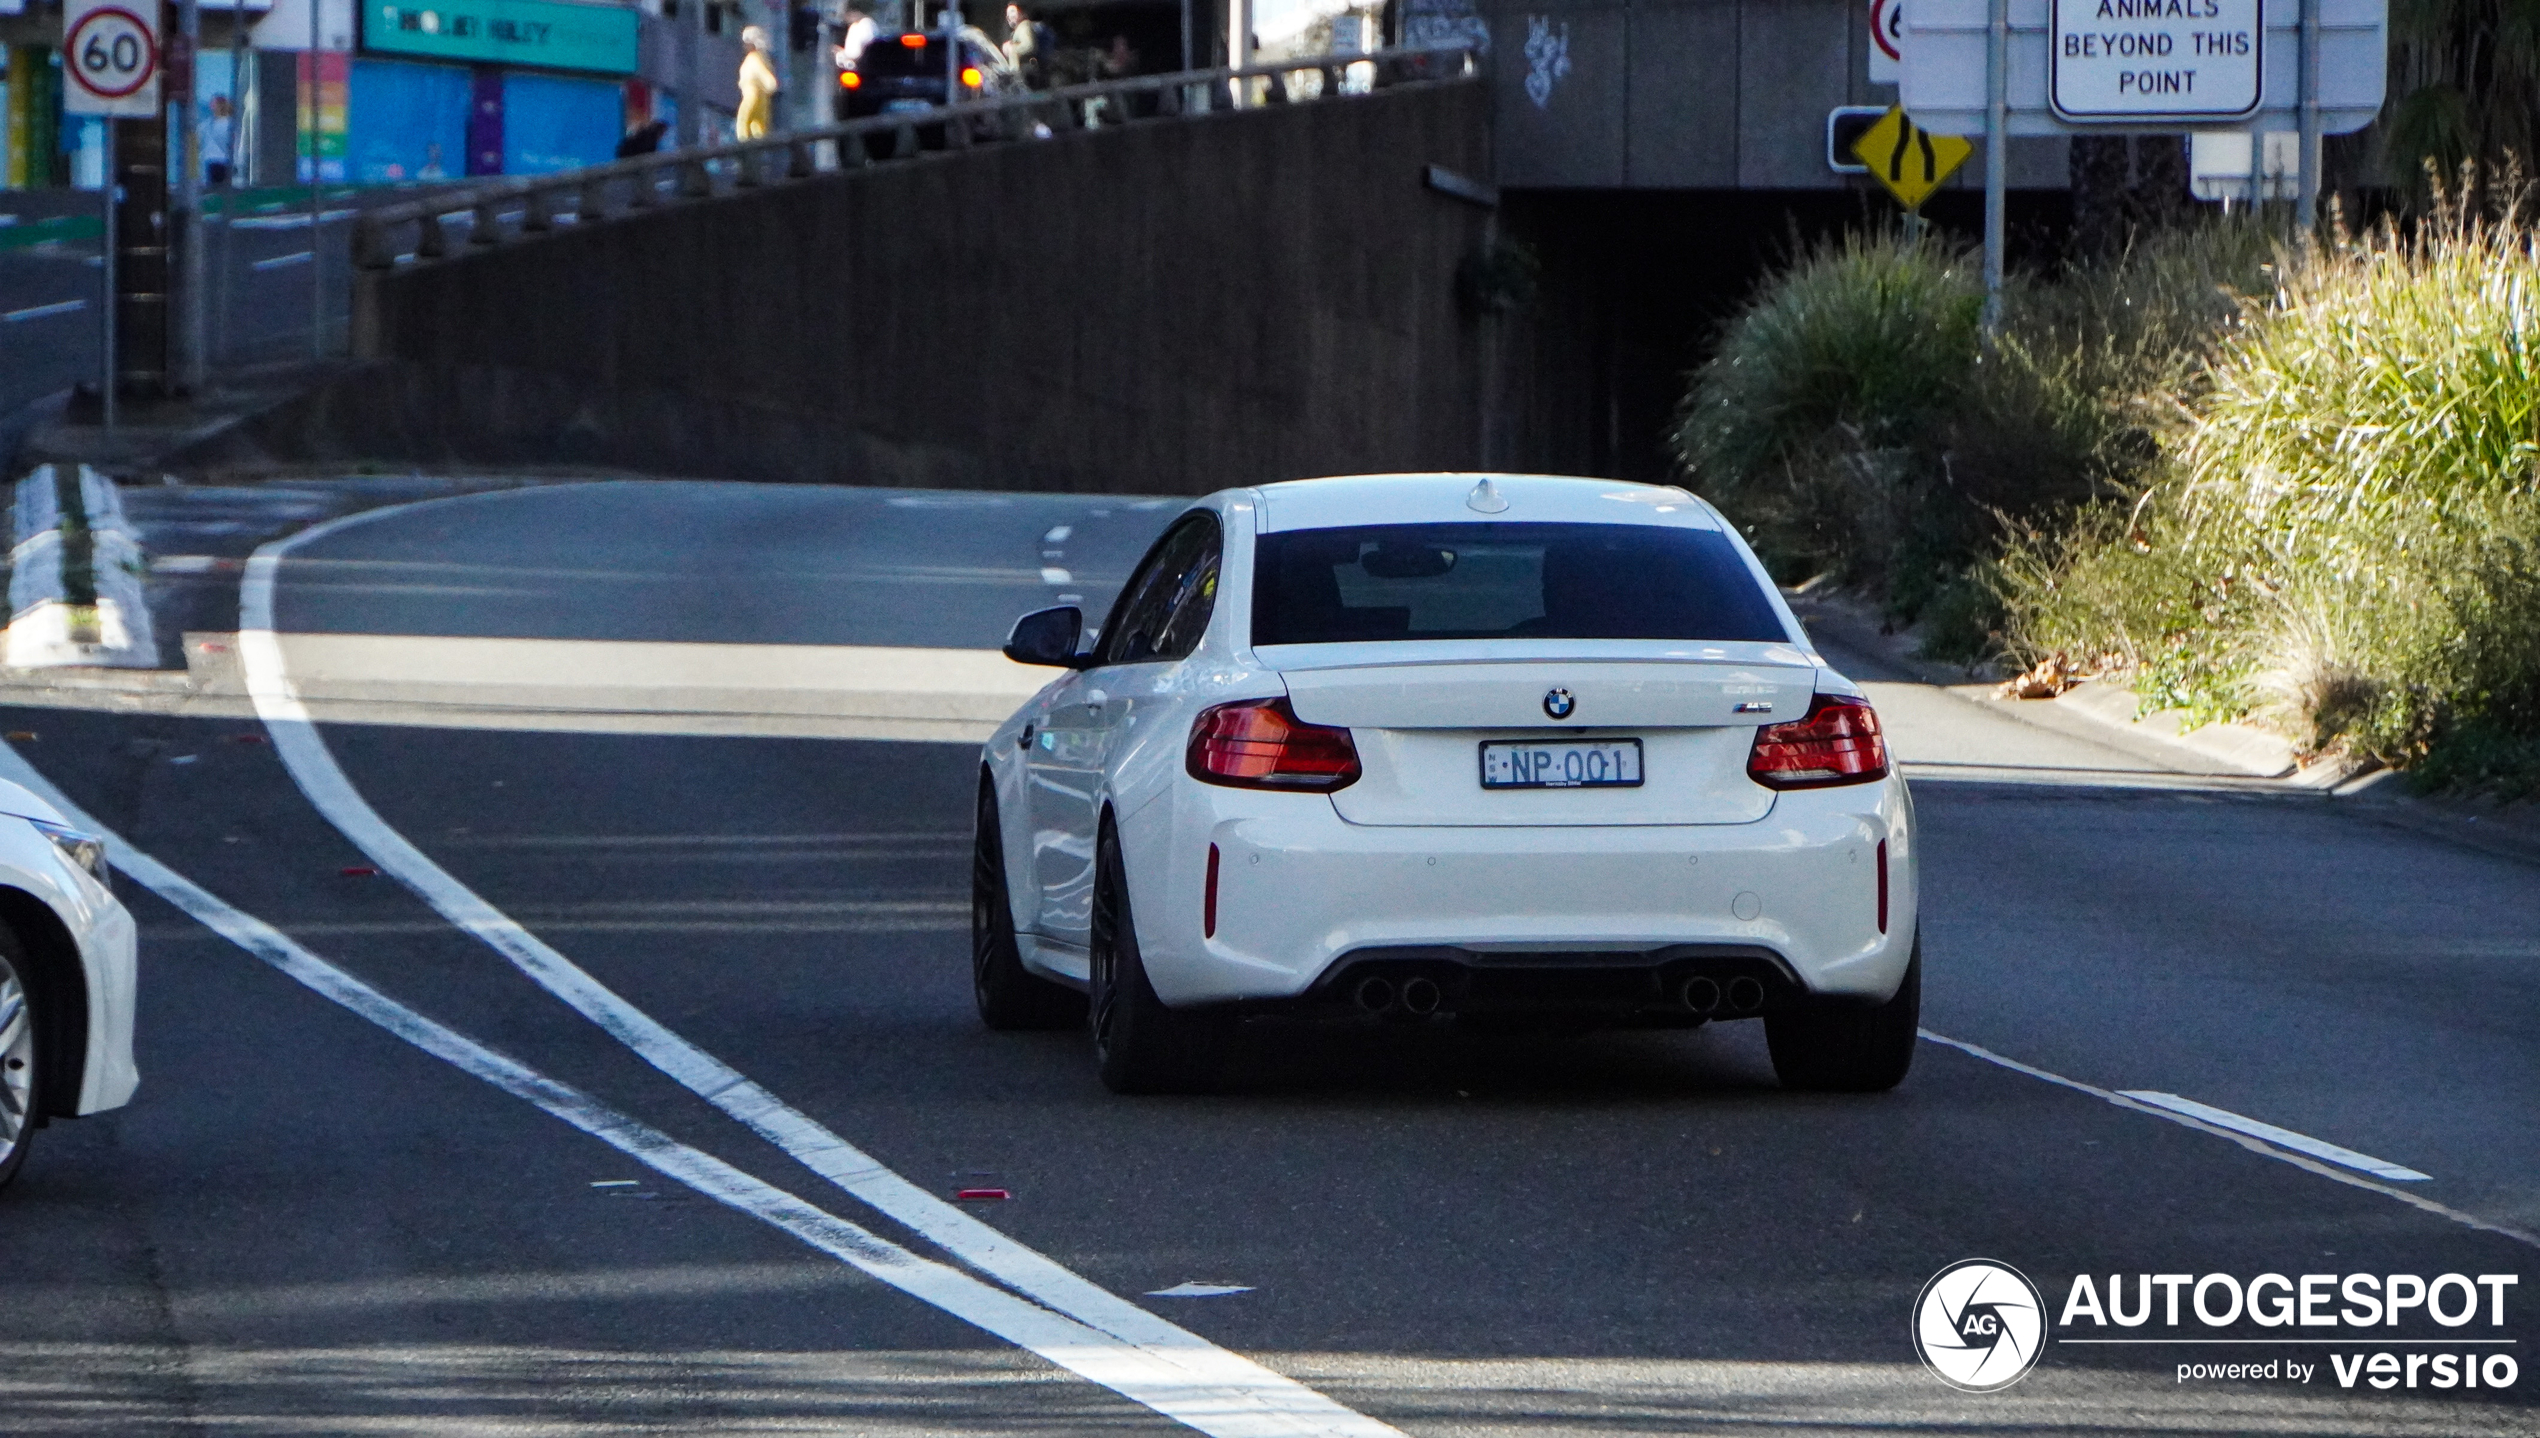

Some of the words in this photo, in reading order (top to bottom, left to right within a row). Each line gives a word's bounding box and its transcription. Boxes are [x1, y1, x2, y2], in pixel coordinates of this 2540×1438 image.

[2096, 0, 2219, 18] ANIMALS
[83, 31, 138, 74] 60
[2064, 32, 2173, 57] BEYOND
[2191, 31, 2249, 56] THIS
[2119, 70, 2197, 93] POINT
